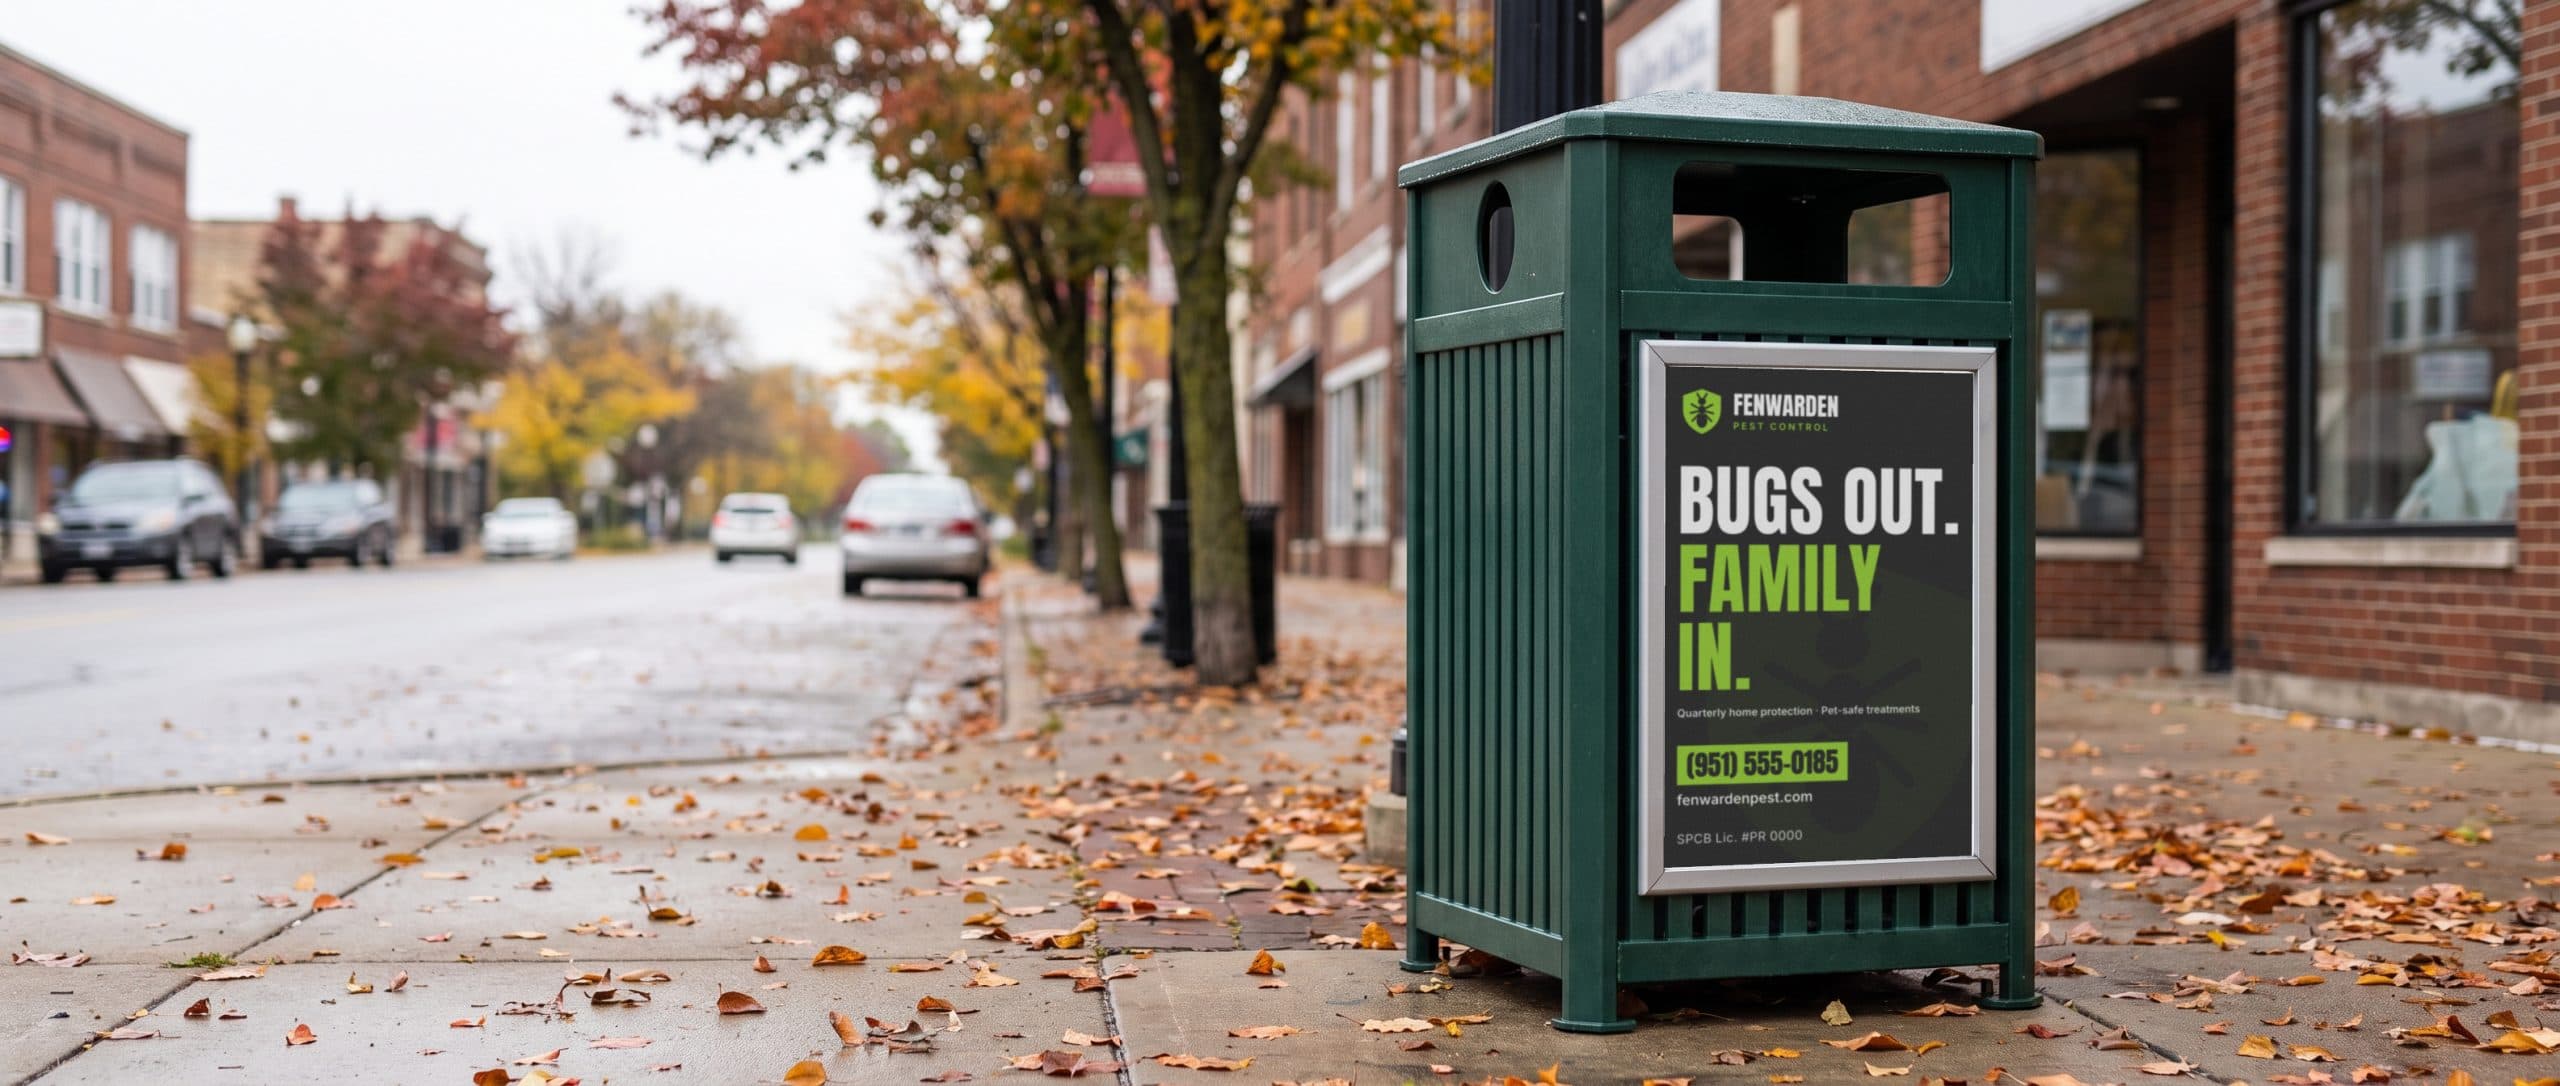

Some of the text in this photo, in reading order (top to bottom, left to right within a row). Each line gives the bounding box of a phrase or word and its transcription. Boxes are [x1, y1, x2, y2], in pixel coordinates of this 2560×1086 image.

[1733, 393, 1839, 418] FENWARDEN
[1733, 421, 1828, 432] PEST CONTROL
[1680, 465, 1959, 535] BUGS OUT.
[1680, 544, 1881, 613] FAMILY
[1679, 622, 1750, 691] IN.
[1677, 704, 1921, 719] Quarterly home protection Pet-safe treatments
[1686, 749, 1839, 780] (951) 555-0185
[1677, 792, 1813, 807] fenwardenpest.com
[1677, 829, 1803, 845] SPCB Lic. #PR 0000
